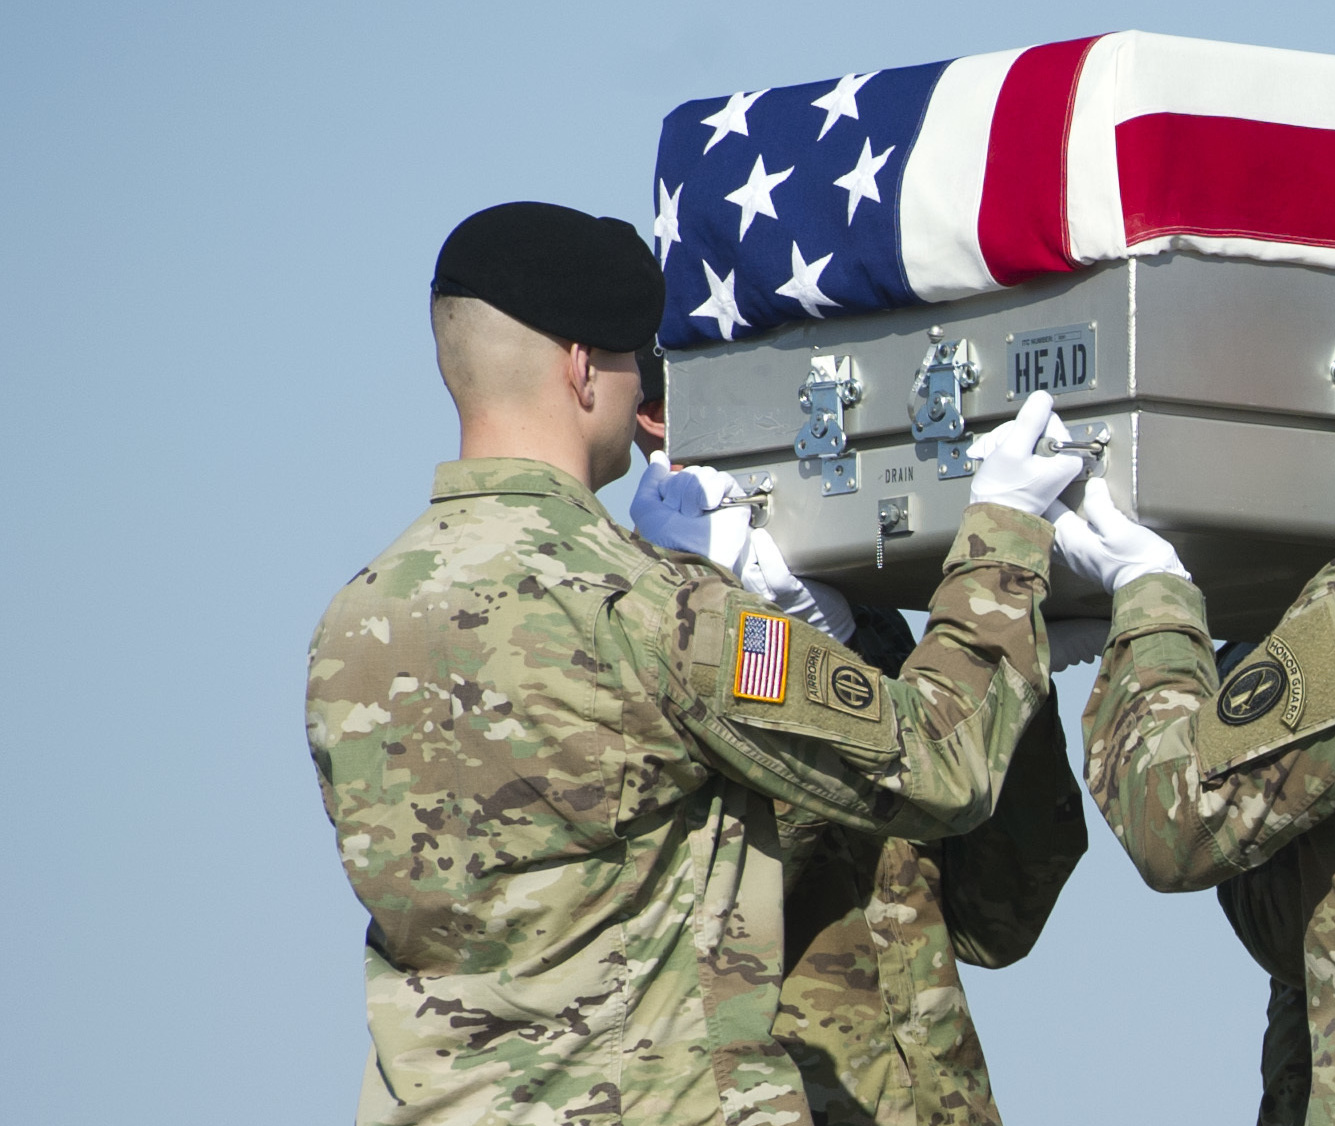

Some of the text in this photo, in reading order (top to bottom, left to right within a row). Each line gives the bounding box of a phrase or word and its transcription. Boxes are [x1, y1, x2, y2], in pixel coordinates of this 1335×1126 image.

[1015, 343, 1087, 394] HEAD
[885, 466, 914, 484] DRAIN
[807, 646, 823, 699] AIRBORNE
[1270, 641, 1301, 721] HONOR GUARD
